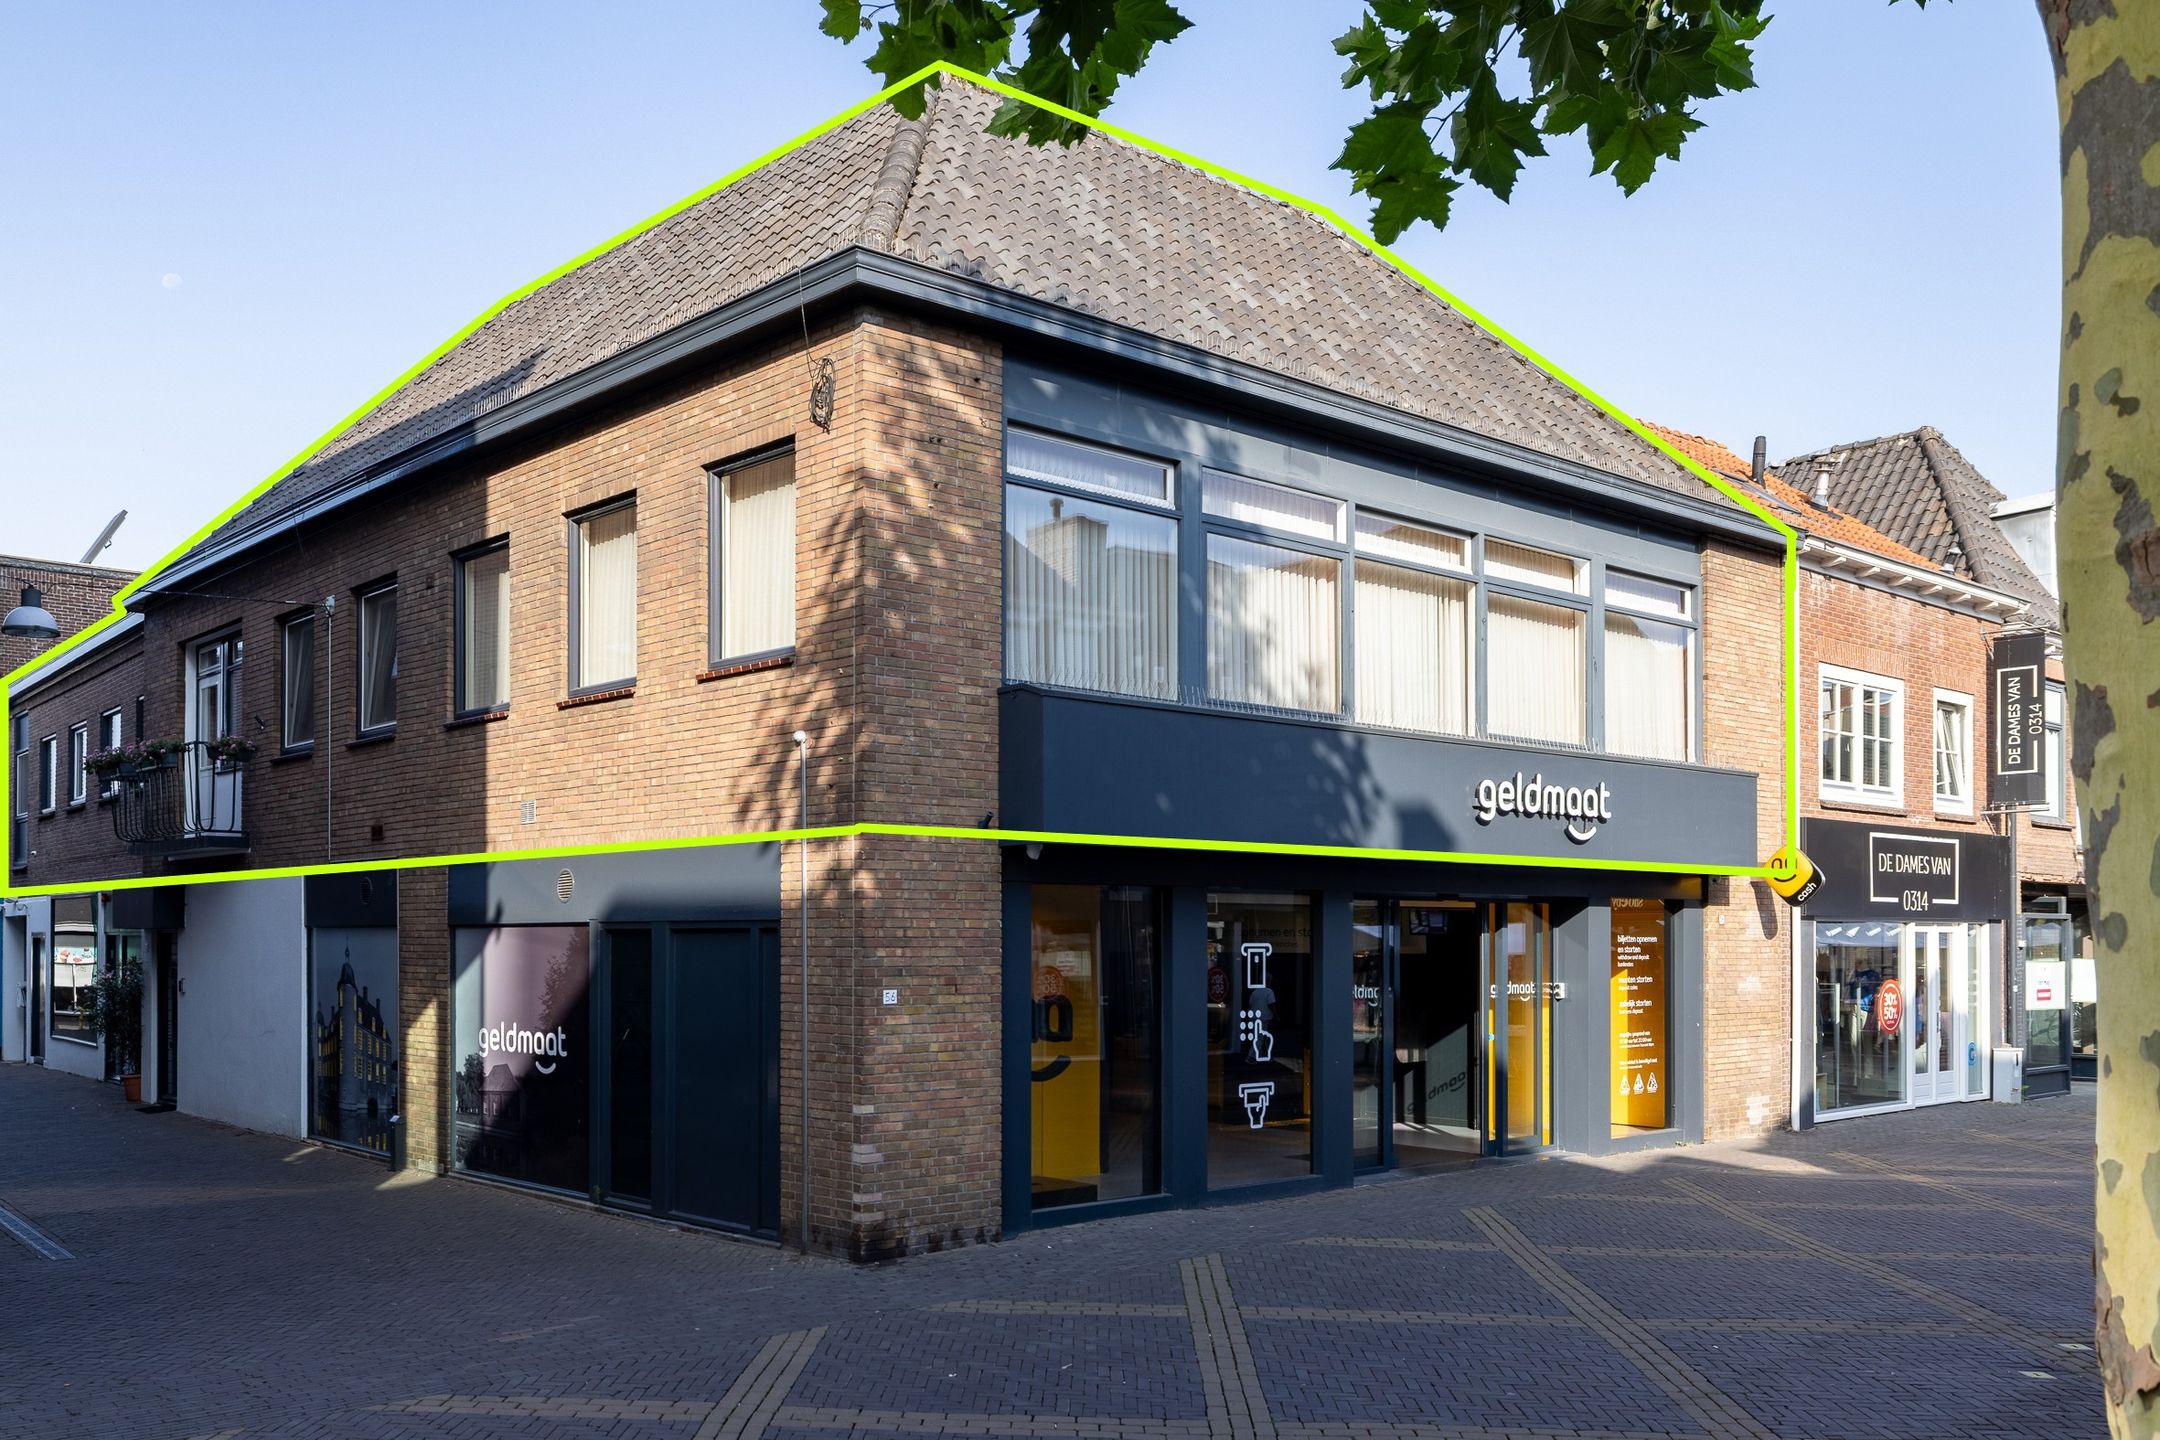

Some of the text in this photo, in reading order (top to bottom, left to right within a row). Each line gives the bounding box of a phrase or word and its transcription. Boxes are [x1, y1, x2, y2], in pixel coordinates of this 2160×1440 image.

[2008, 677, 2020, 764] DE DAMES VAN
[2029, 703, 2042, 735] 0314
[1478, 771, 1612, 822] geldmaat
[1878, 852, 1951, 876] DE DAMES VAN
[1797, 882, 1817, 901] cash
[1903, 890, 1929, 911] 0314
[1490, 980, 1536, 999] gdmaat
[1883, 1006, 1898, 1020] 50%
[478, 1021, 568, 1058] geldmaat
